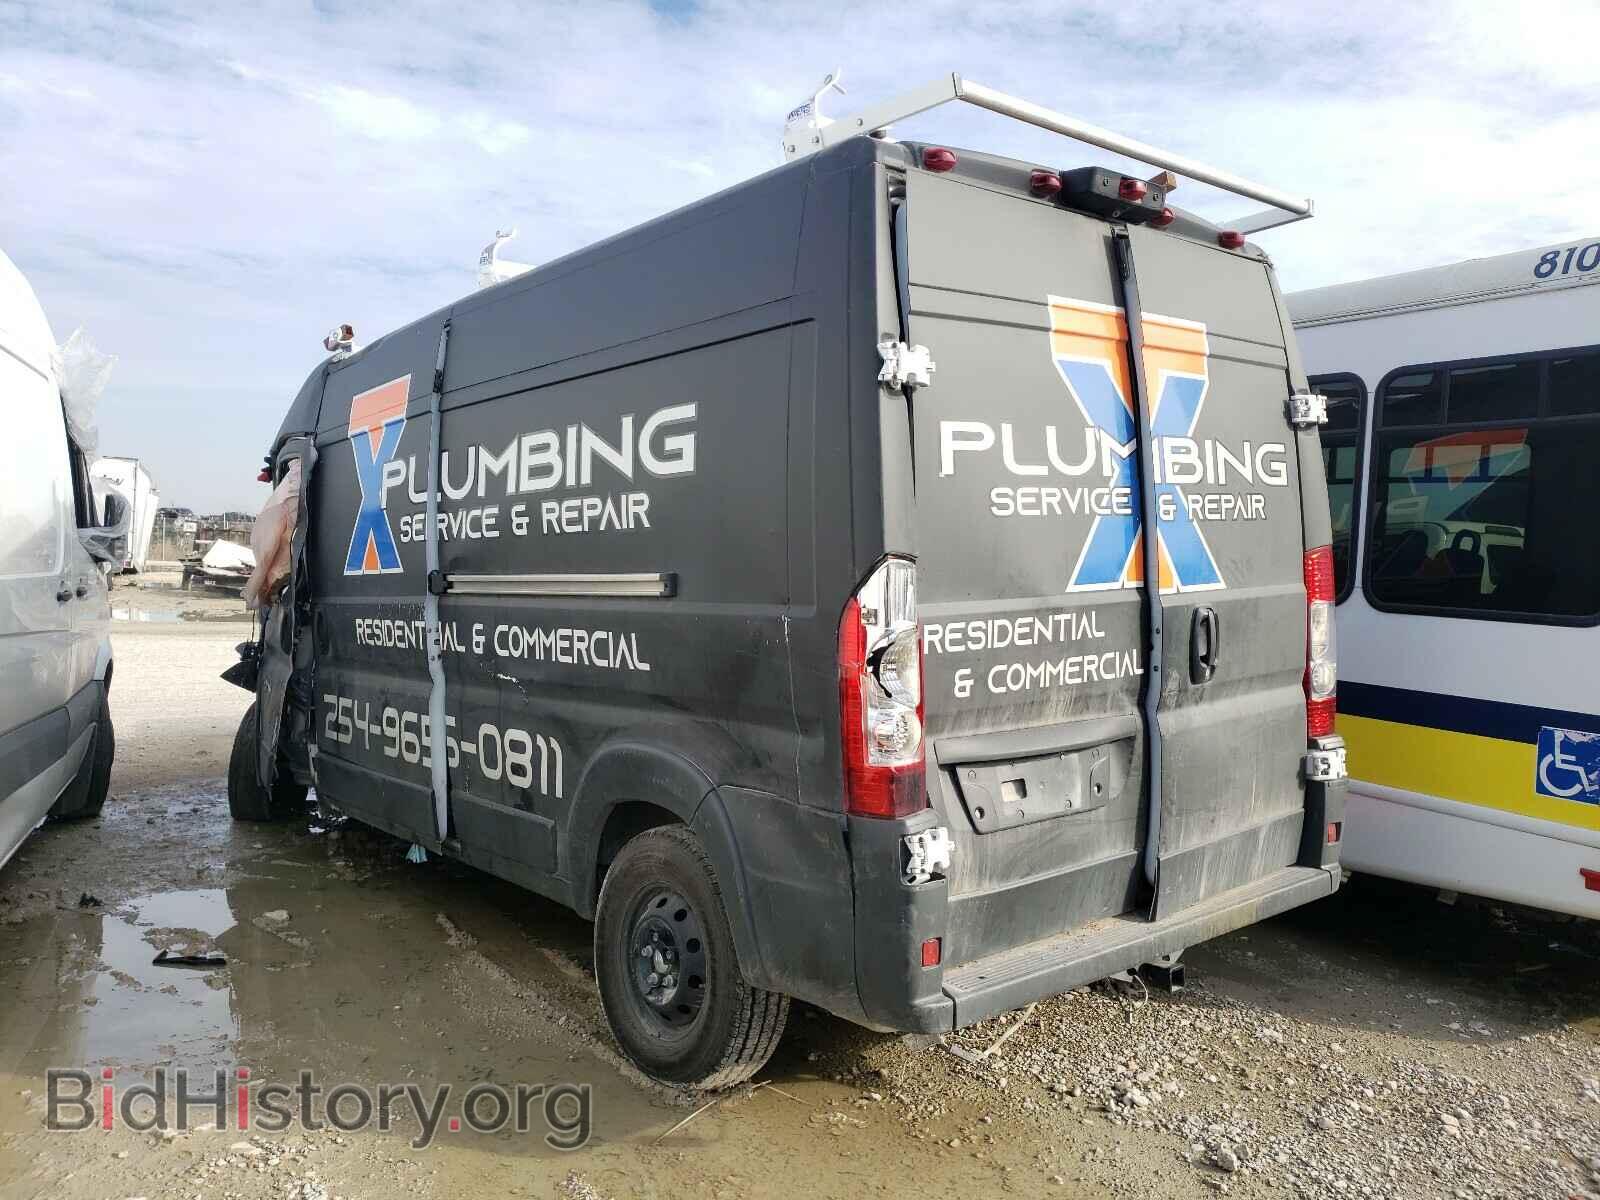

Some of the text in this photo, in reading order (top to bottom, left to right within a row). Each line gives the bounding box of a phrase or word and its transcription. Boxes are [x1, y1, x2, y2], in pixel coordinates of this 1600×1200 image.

[1534, 242, 1600, 278] 810
[381, 403, 698, 511] PLUMBING
[938, 420, 1289, 486] PLUMBING
[400, 493, 652, 543] SERVICE & REPAIR
[990, 487, 1267, 521] SERVICE & REPAIR
[355, 619, 652, 671] RESIDENTIAL & COMMERCIAL
[923, 611, 1106, 655] RESIDENTIAL
[953, 649, 1145, 698] & COMMERCIAL
[323, 694, 563, 799] 254-965-0811
